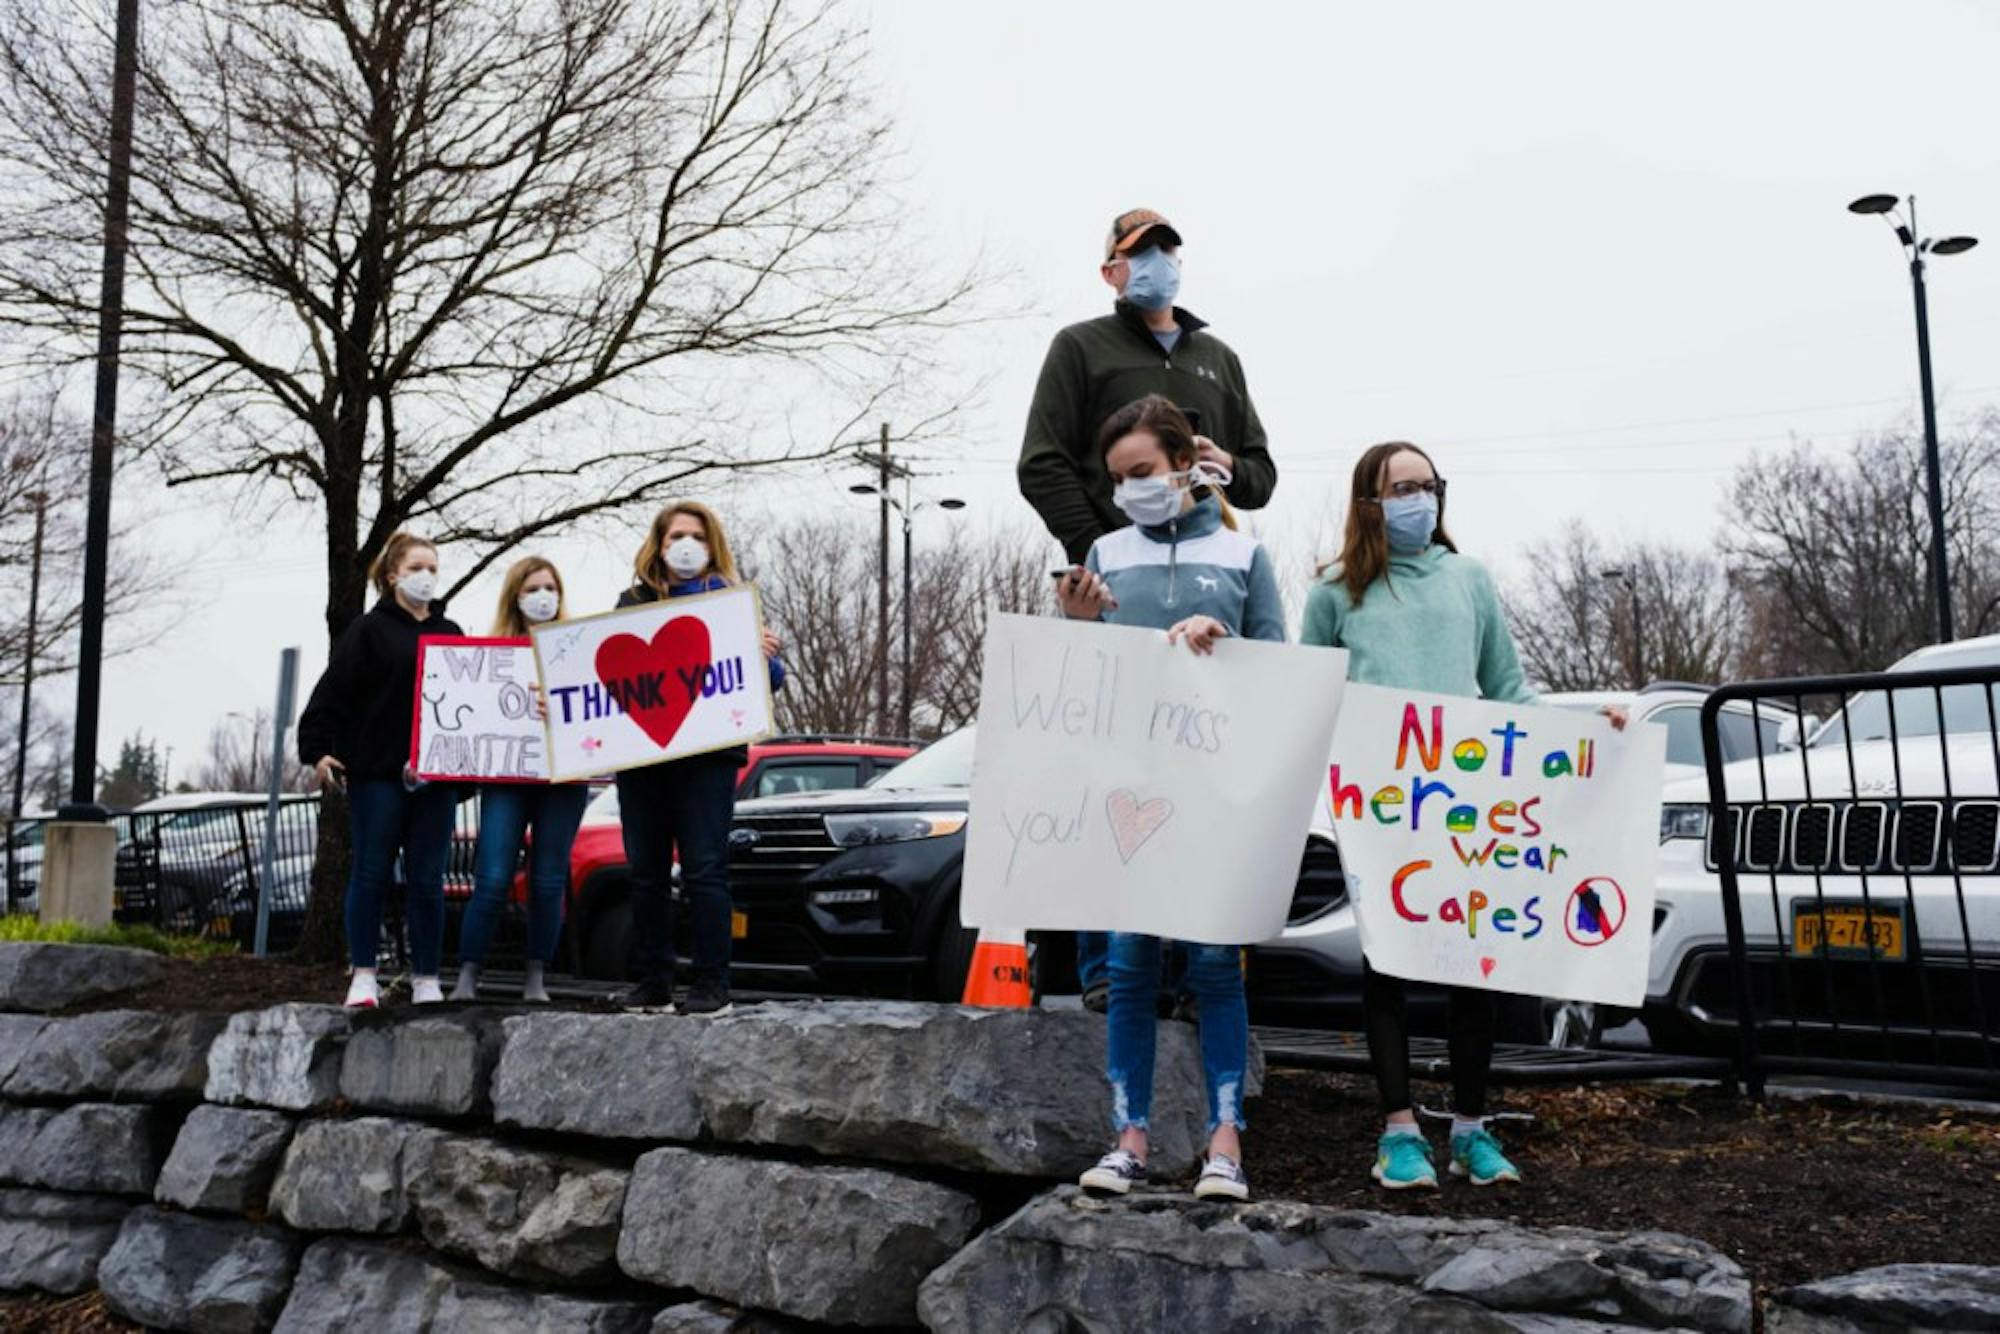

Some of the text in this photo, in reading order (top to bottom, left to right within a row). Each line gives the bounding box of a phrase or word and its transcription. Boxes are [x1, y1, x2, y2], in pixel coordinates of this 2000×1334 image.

[443, 647, 514, 682] WE
[550, 656, 745, 724] THANK YOU!
[424, 734, 541, 777] AUNTIE
[1148, 693, 1229, 754] miss
[1395, 702, 1595, 778] Not all
[1329, 763, 1542, 837] heroes
[1002, 786, 1088, 887] you!
[1391, 859, 1543, 940] Capes
